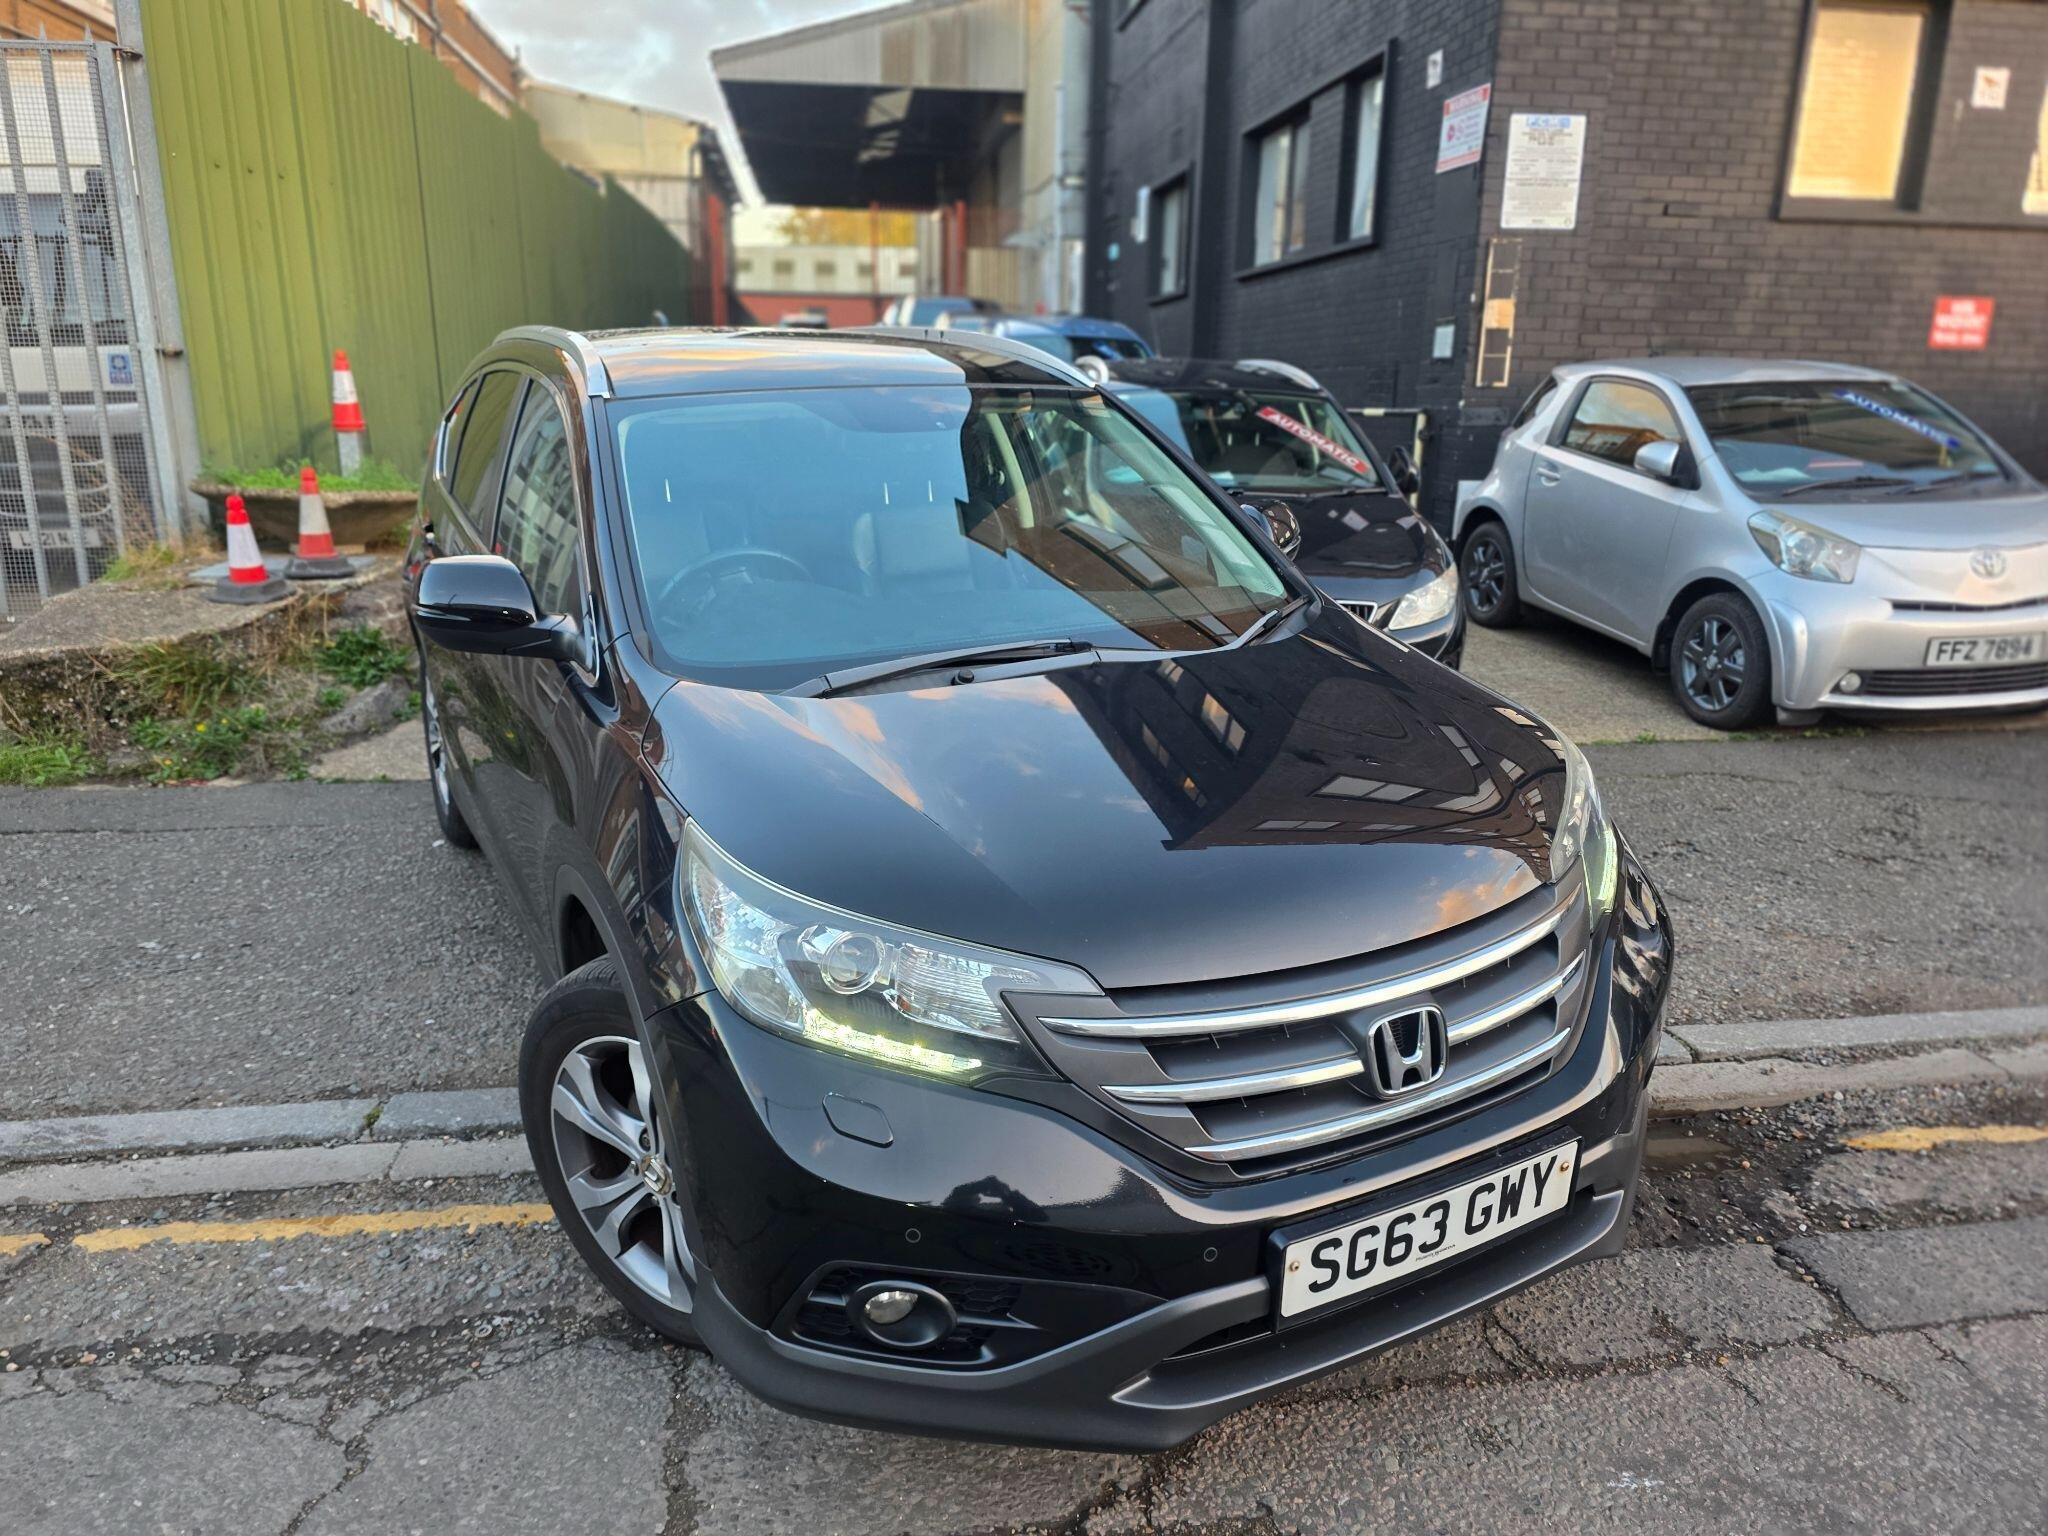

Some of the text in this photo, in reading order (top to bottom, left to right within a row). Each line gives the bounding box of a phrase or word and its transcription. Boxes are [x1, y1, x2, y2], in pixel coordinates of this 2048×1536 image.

[1269, 411, 1360, 467] AUTOMATIC
[1935, 640, 1979, 661] FFZ
[1308, 1154, 1558, 1294] SG63 GWY
